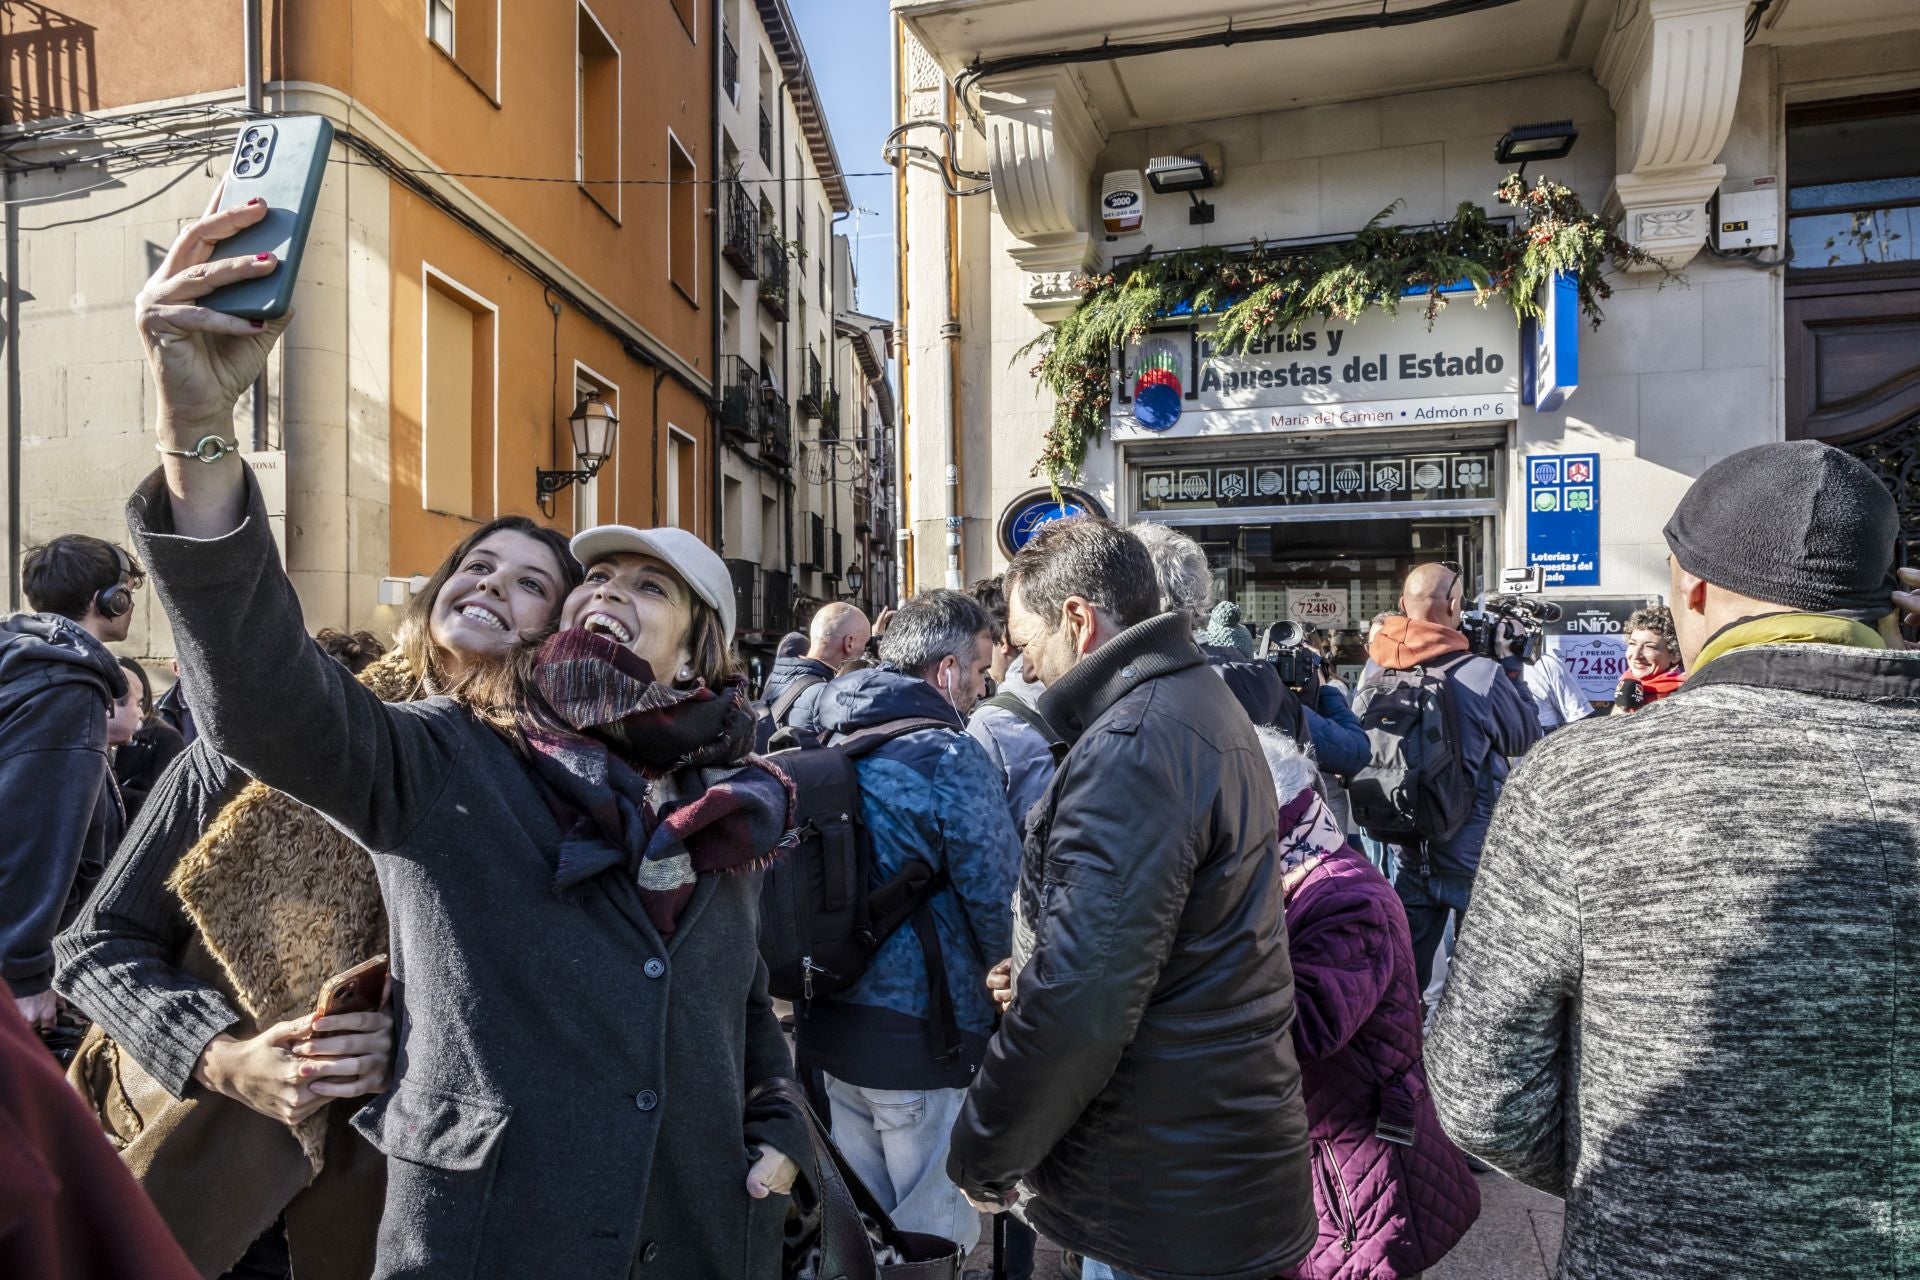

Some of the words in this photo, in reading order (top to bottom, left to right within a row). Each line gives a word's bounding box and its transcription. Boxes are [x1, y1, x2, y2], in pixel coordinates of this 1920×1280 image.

[1111, 197, 1131, 207] 2000
[1326, 329, 1344, 357] y
[1200, 361, 1333, 397] Apuestas
[1342, 353, 1388, 384] del
[1399, 346, 1505, 380] Estado
[1271, 413, 1309, 427] María
[1314, 412, 1335, 424] del
[1339, 411, 1393, 423] Carmen
[1414, 405, 1468, 420] Admón
[1473, 403, 1490, 416] nº
[1494, 402, 1504, 415] 6
[1531, 551, 1571, 562] Loterías
[1572, 553, 1580, 563] y
[1577, 561, 1593, 571] del
[1299, 602, 1336, 614] 72480
[1579, 616, 1621, 634] Niño
[1564, 657, 1629, 675] 72480
